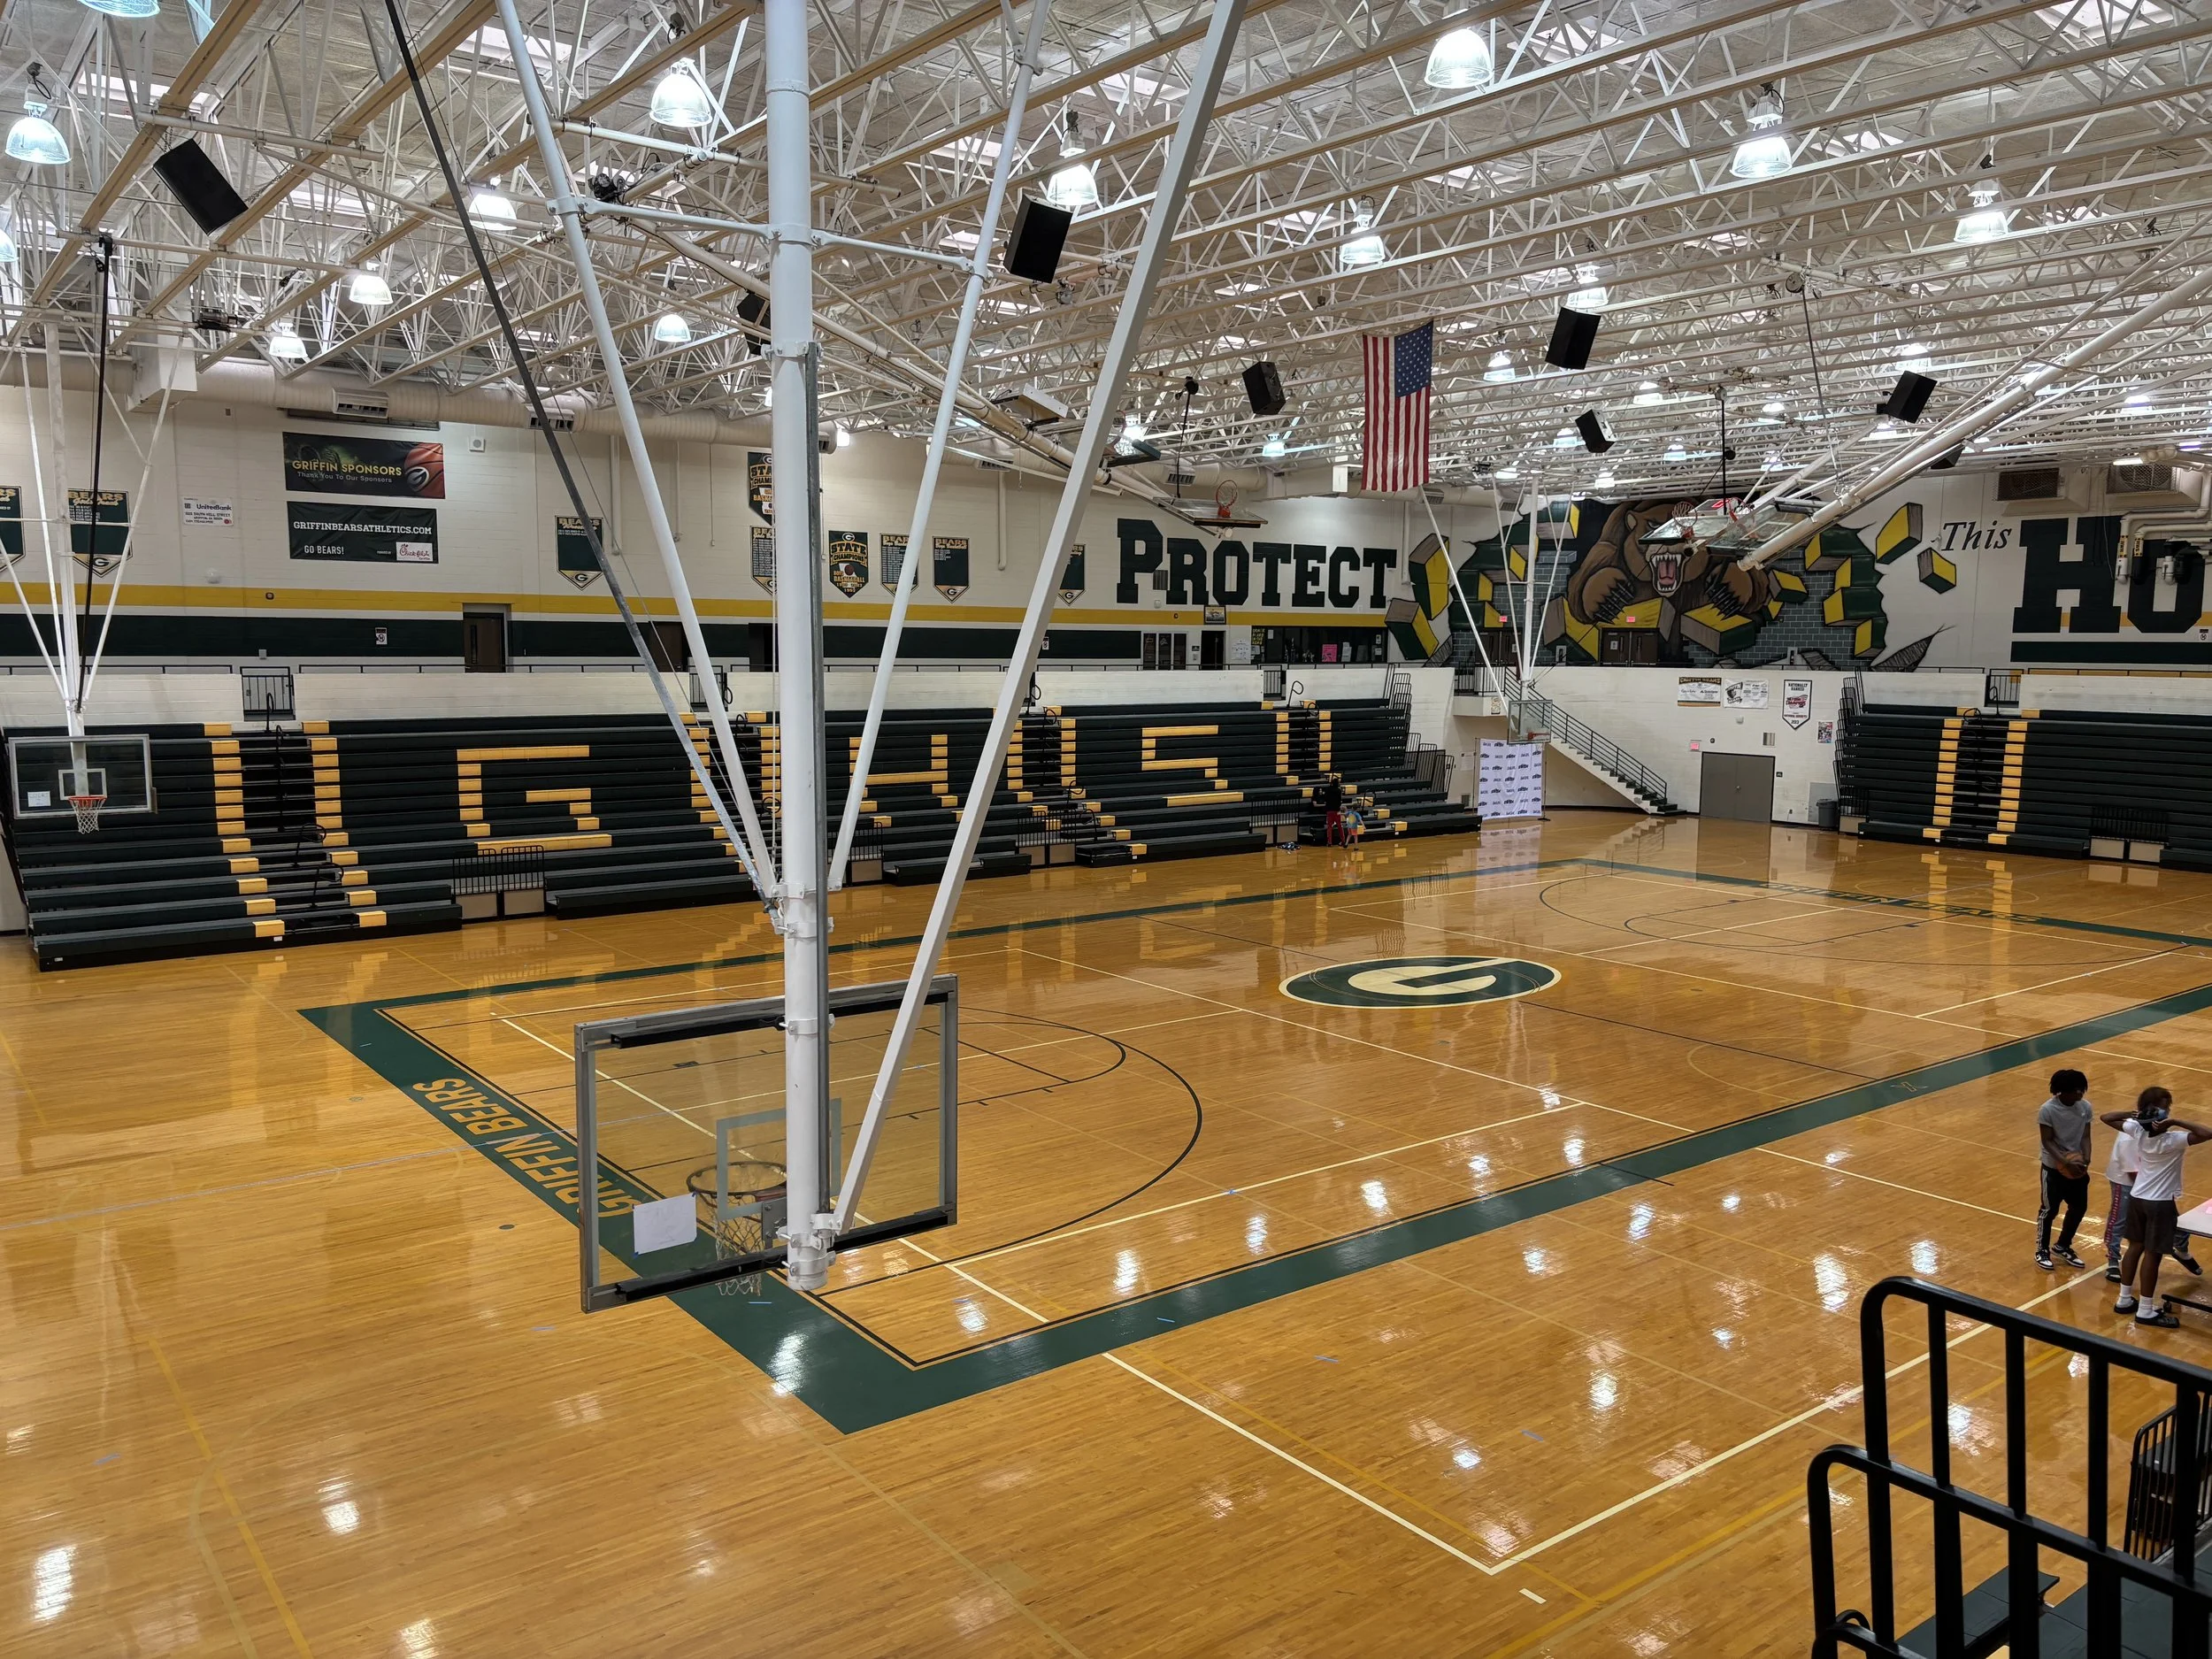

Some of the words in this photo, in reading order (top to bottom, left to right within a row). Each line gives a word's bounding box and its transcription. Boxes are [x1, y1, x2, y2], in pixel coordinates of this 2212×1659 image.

[292, 460, 338, 472] GRIFFIN
[342, 464, 403, 476] SPONSORS
[750, 465, 772, 478] STA
[293, 521, 432, 534] GRIFFINBEARSATHLETICS.COM
[1941, 520, 2012, 551] This
[304, 545, 315, 554] GO
[317, 545, 344, 555] BEARS!
[830, 541, 867, 556] STATE
[833, 552, 865, 561] CHAMPIONS
[1117, 518, 1398, 609] PROTECT
[412, 1078, 528, 1135] BEARS
[487, 1133, 642, 1218] GRIFFIN
